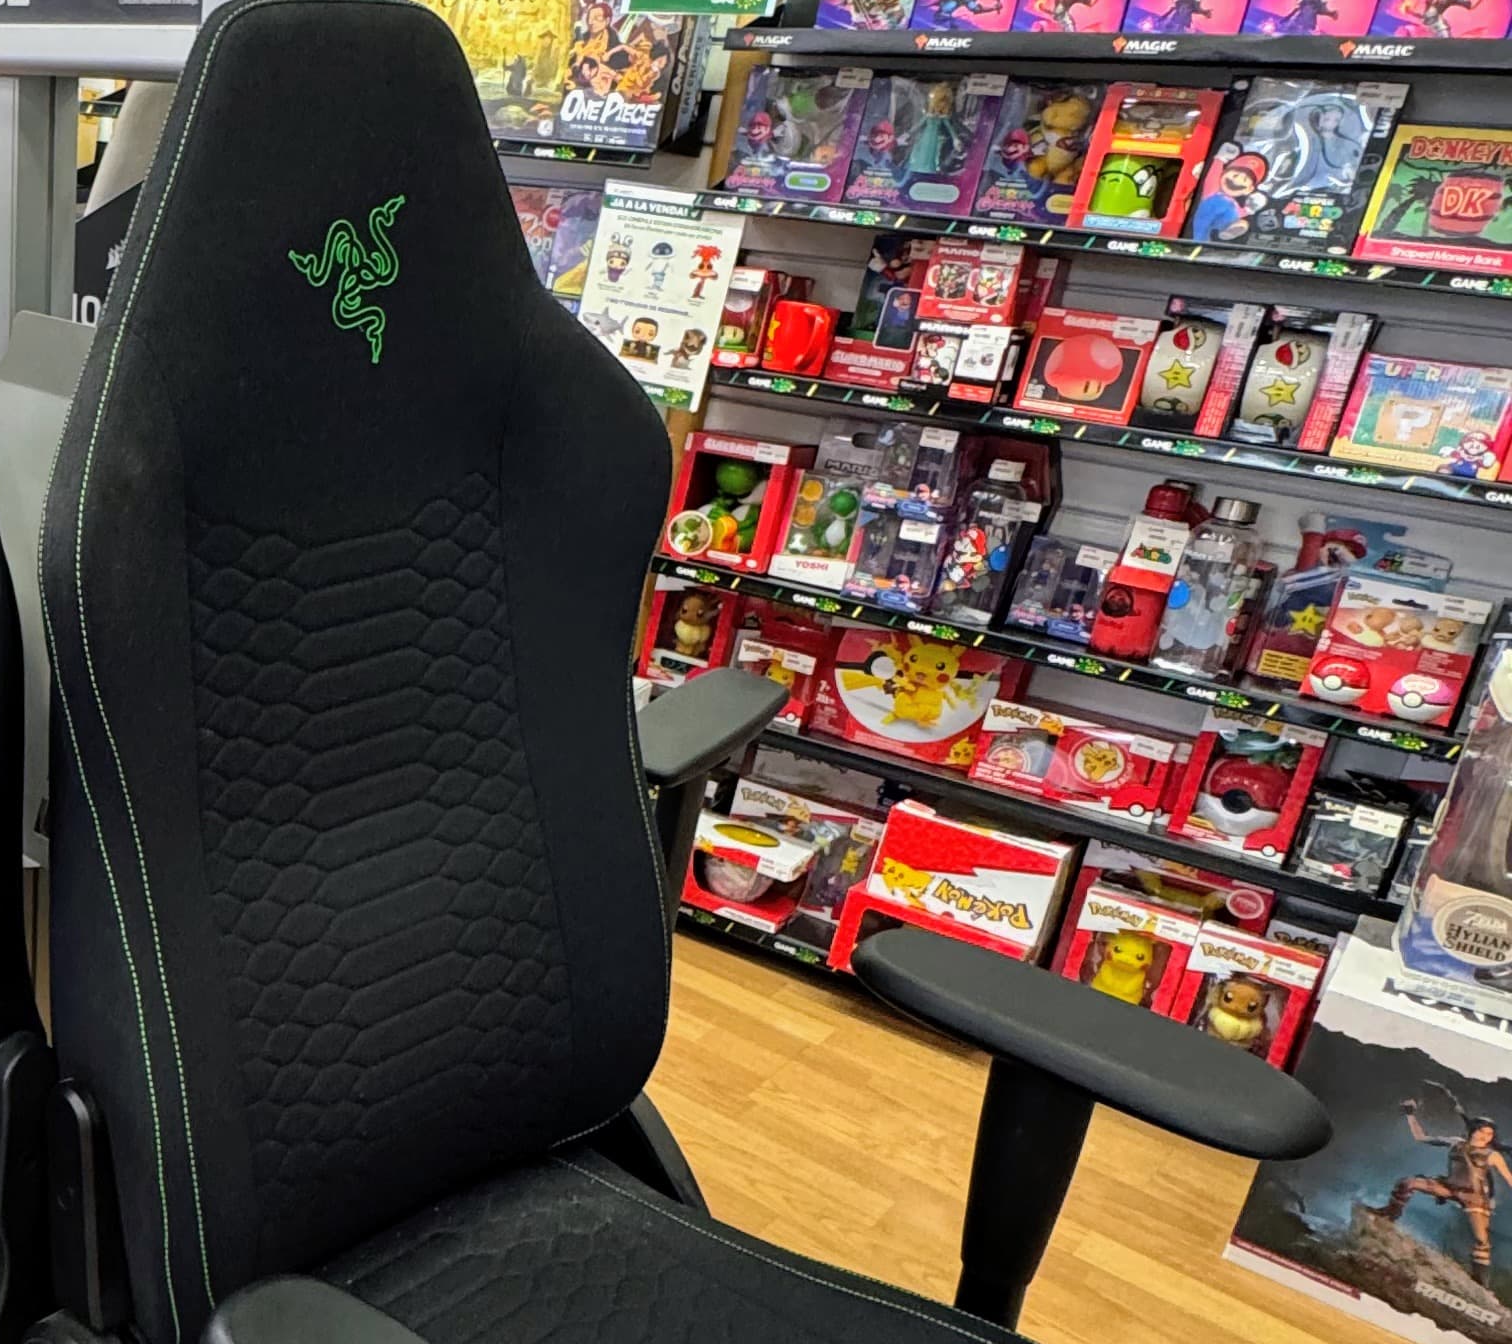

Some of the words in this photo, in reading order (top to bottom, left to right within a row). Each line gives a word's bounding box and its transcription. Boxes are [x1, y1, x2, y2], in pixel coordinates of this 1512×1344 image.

[752, 34, 793, 46] MAGIC
[926, 37, 973, 49] MAGIC
[1125, 39, 1178, 53] MAGIC
[1354, 44, 1416, 56] MAGIC
[560, 89, 602, 123] ONE
[599, 93, 664, 127] PIECE
[1410, 136, 1499, 164] DONKEY
[1440, 186, 1493, 217] DK
[1106, 239, 1138, 253] GAME
[1279, 258, 1314, 272] GAME
[1435, 251, 1473, 265] Money
[1474, 254, 1504, 267] Bank
[1450, 277, 1489, 291] GAME
[795, 559, 830, 572] YOSHI
[1186, 686, 1218, 701] GAME
[1357, 725, 1392, 742] GAME
[1450, 923, 1512, 951] HYLIAN
[1443, 931, 1506, 962] SHIELD
[1414, 1283, 1502, 1327] RAIDER
